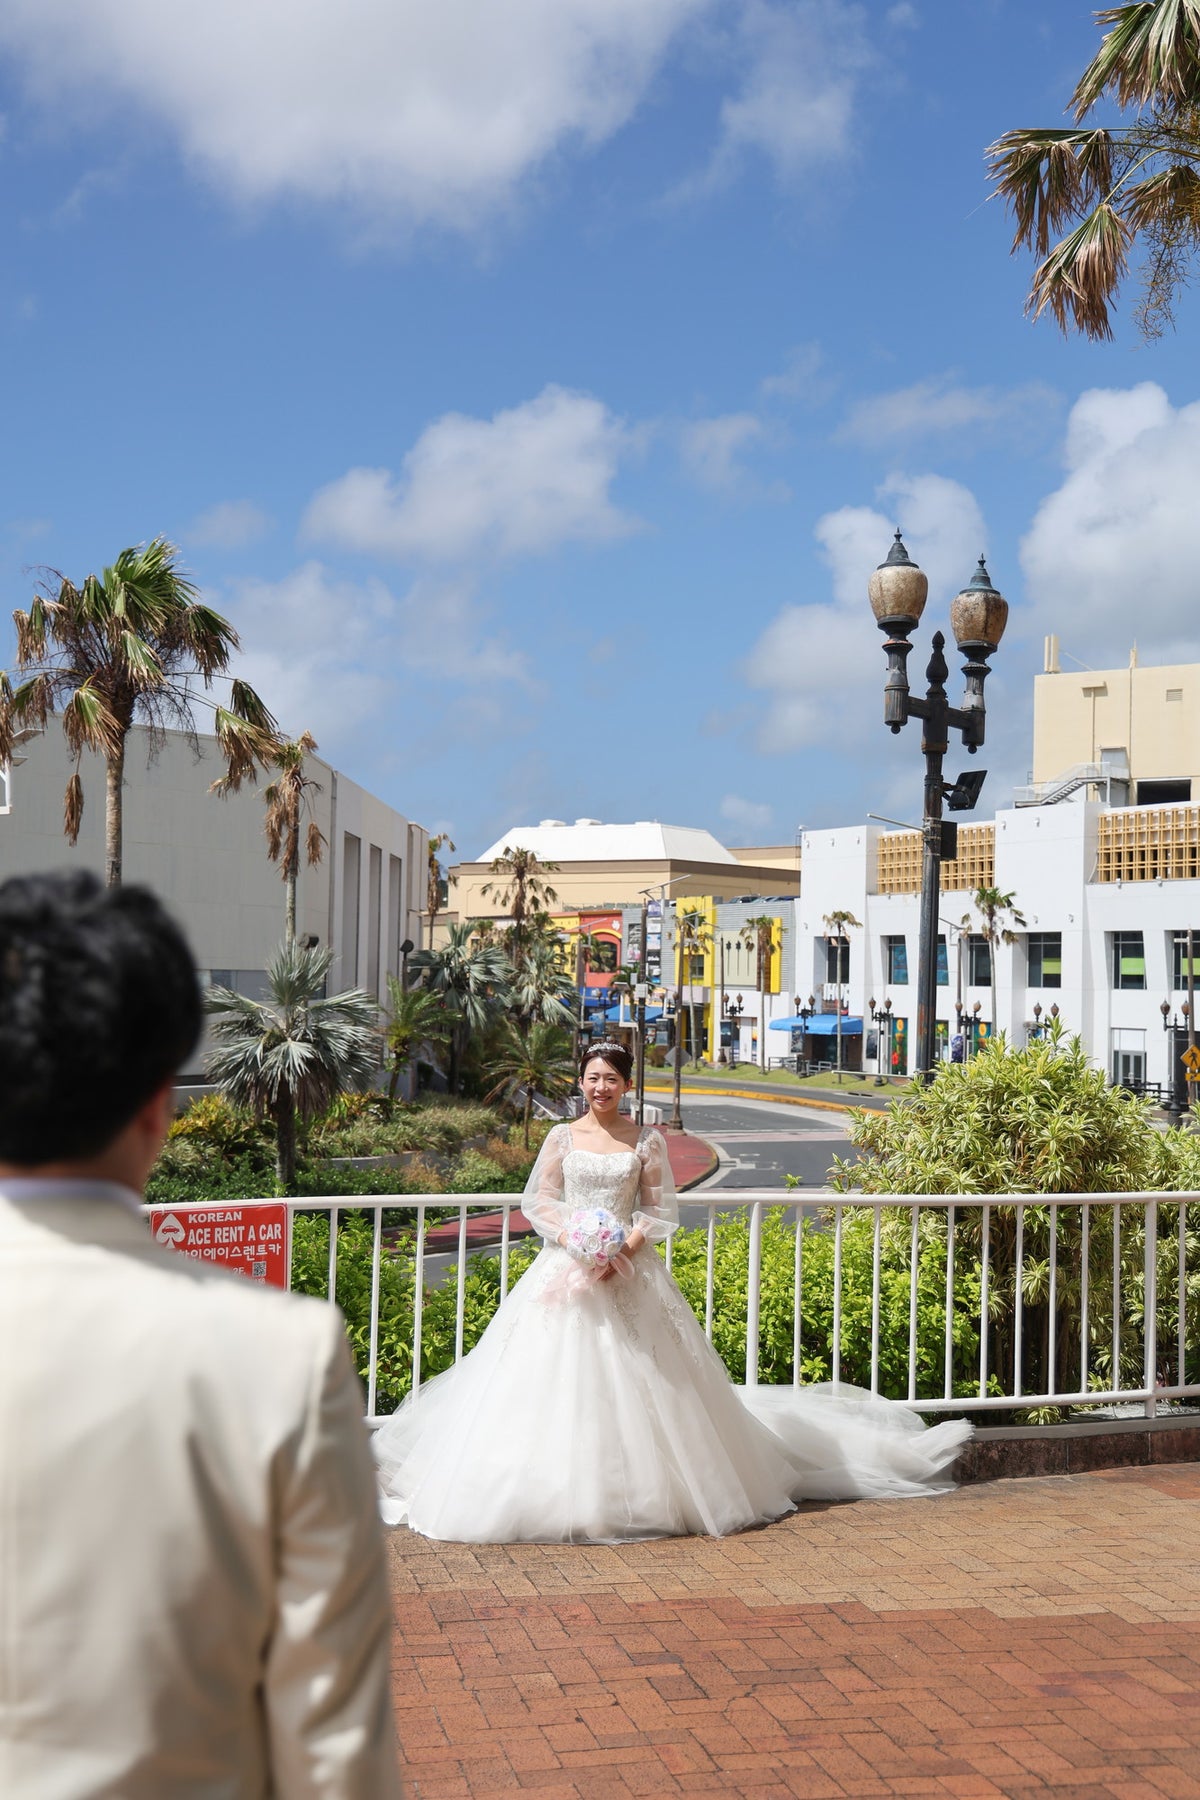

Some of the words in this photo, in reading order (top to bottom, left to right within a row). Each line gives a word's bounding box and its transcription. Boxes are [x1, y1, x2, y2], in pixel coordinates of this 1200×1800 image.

[188, 1211, 242, 1224] KOREAN
[187, 1228, 211, 1245] ACE
[214, 1226, 245, 1243] RENT
[247, 1225, 256, 1241] A
[259, 1223, 282, 1240] CAR
